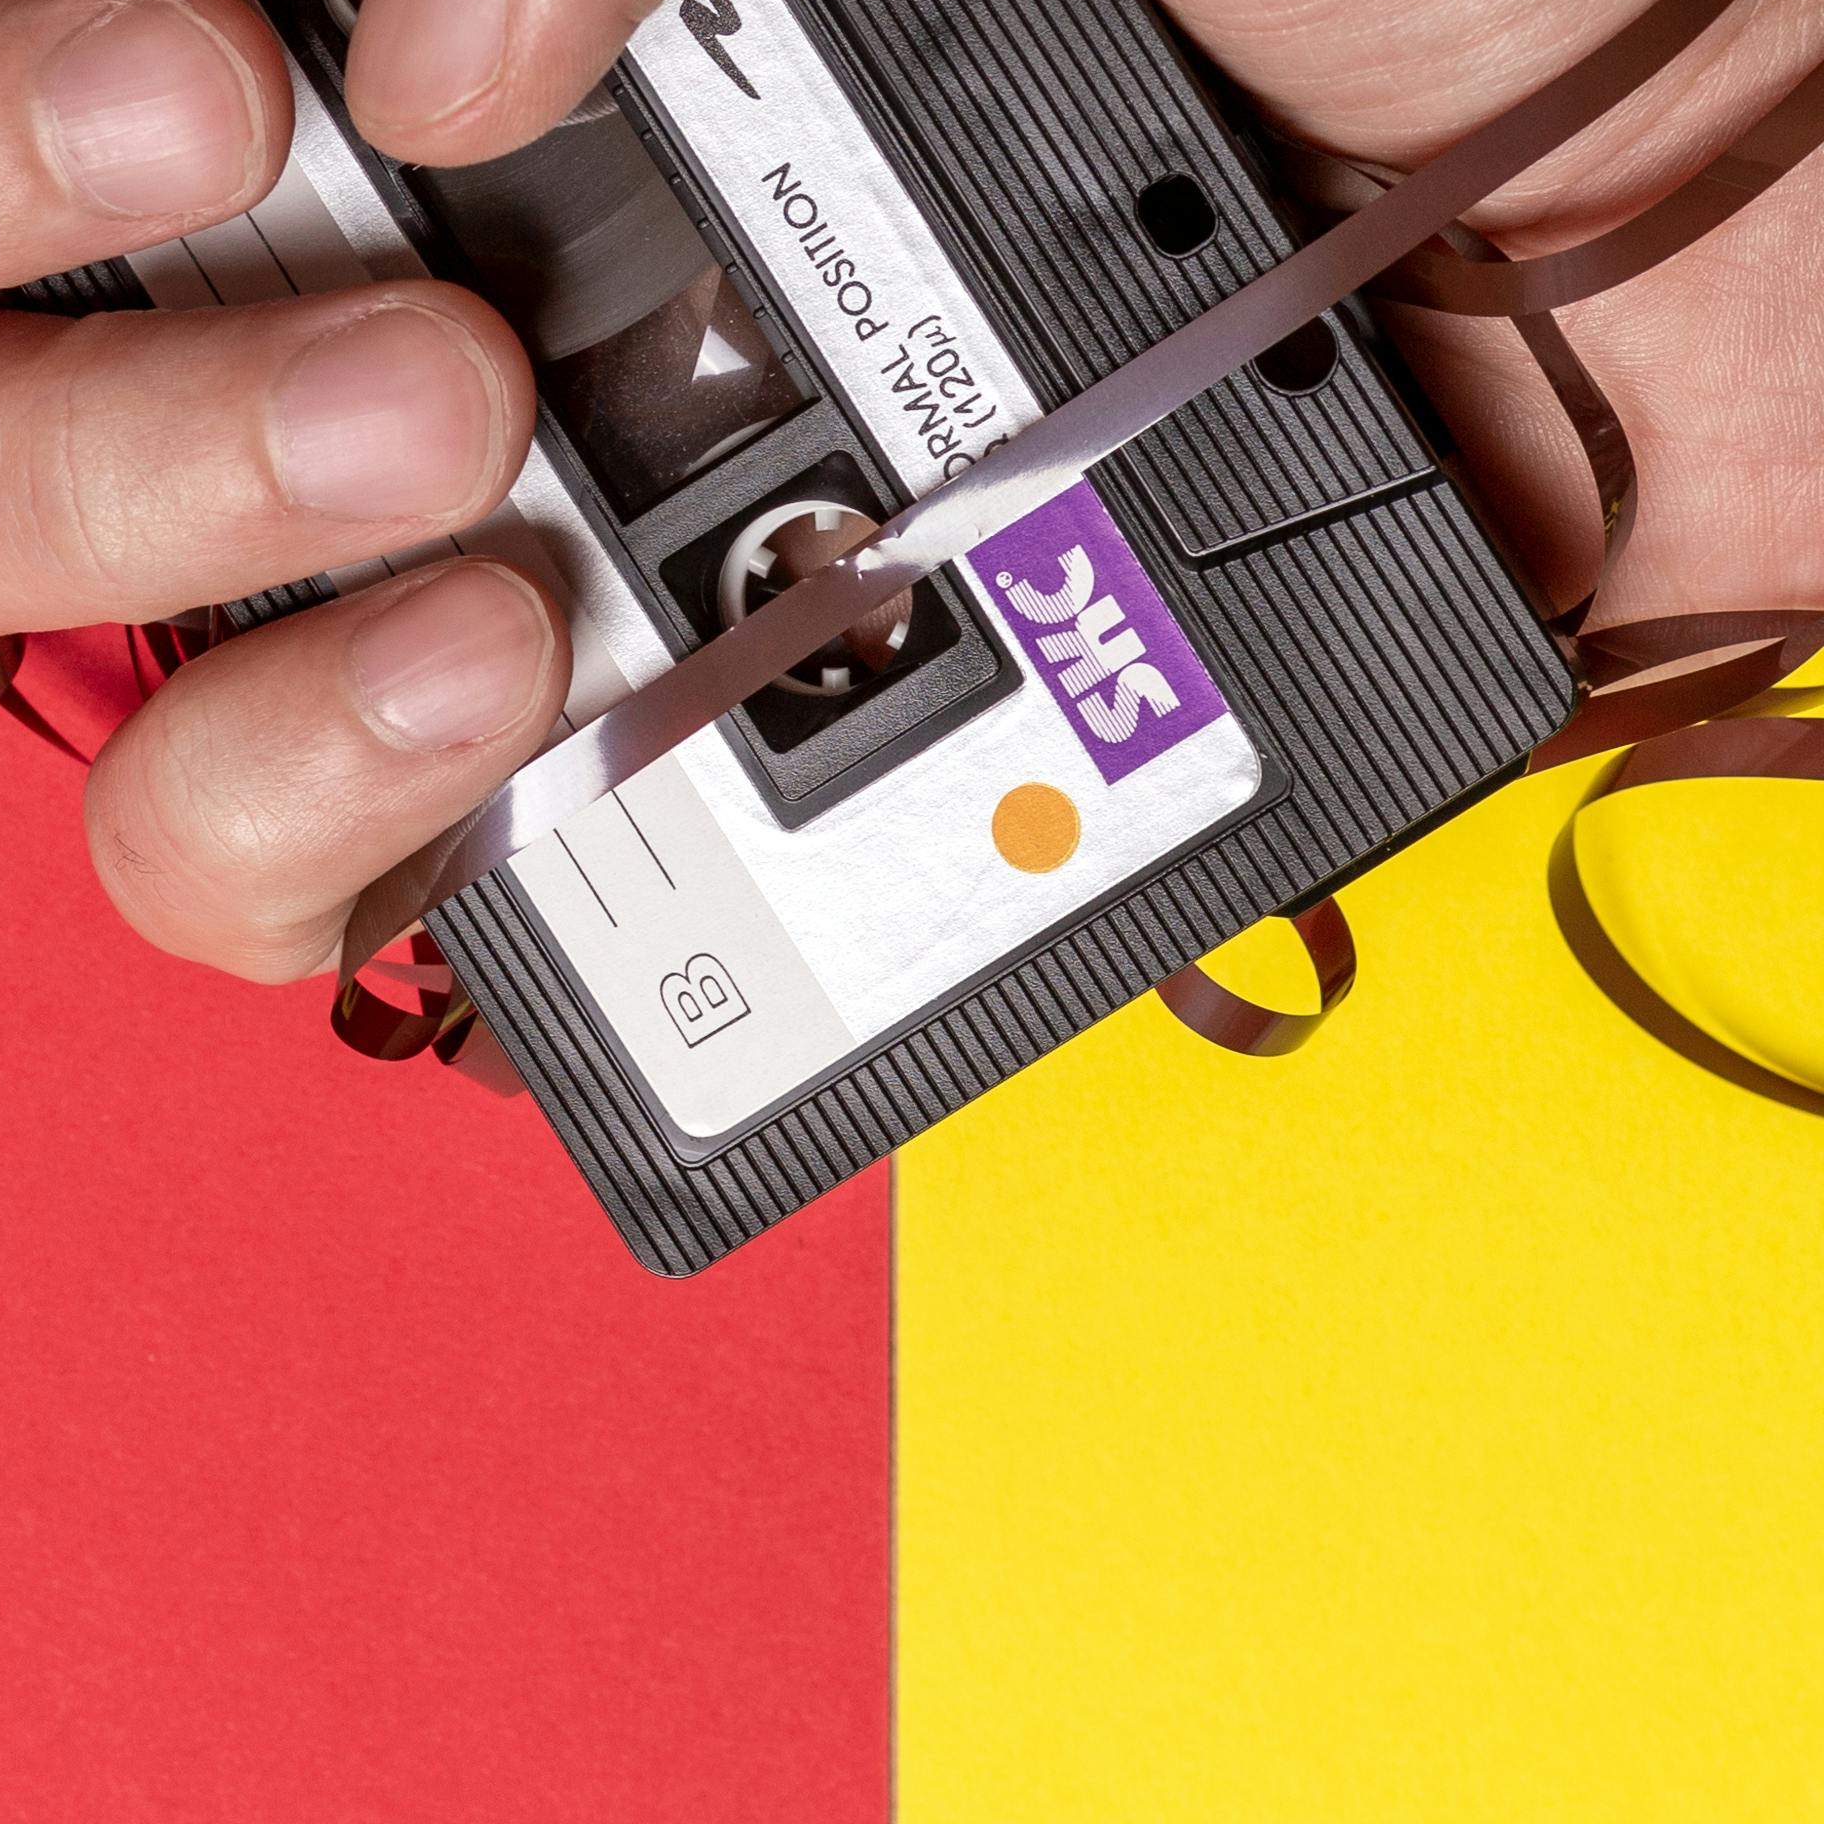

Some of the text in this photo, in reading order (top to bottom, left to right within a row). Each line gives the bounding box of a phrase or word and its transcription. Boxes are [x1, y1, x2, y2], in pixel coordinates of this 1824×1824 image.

[761, 162, 976, 481] ORMAL POSITION
[659, 951, 751, 1049] B
